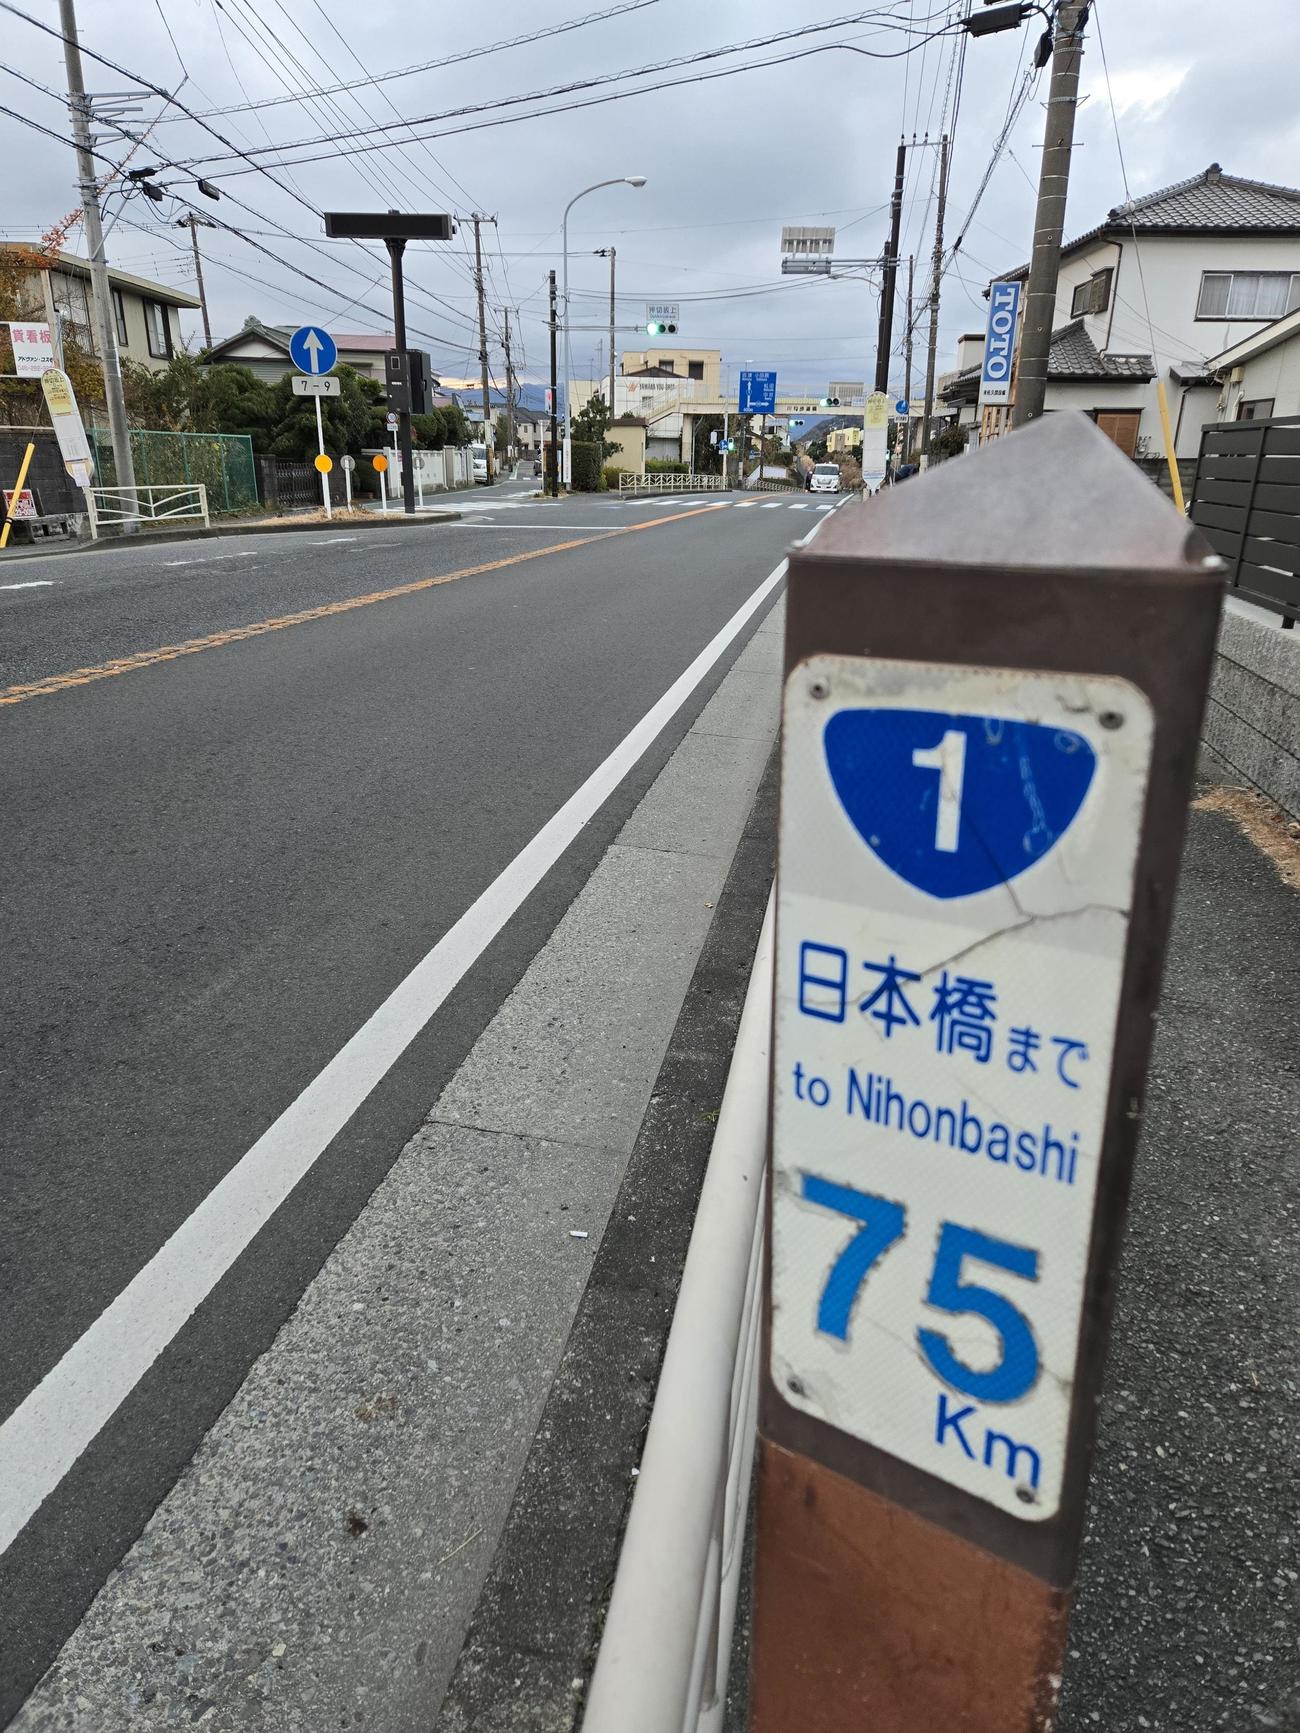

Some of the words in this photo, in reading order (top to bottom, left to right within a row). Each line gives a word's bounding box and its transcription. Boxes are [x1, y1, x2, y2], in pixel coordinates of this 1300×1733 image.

[12, 328, 52, 343] 貸看板
[987, 287, 1016, 379] TOTO
[912, 730, 967, 853] 1
[799, 940, 1088, 1089] 日本橋まで
[793, 1062, 830, 1107] to
[846, 1067, 1080, 1185] Nihonbashi
[801, 1171, 1041, 1405] 75
[935, 1393, 1041, 1490] Km
